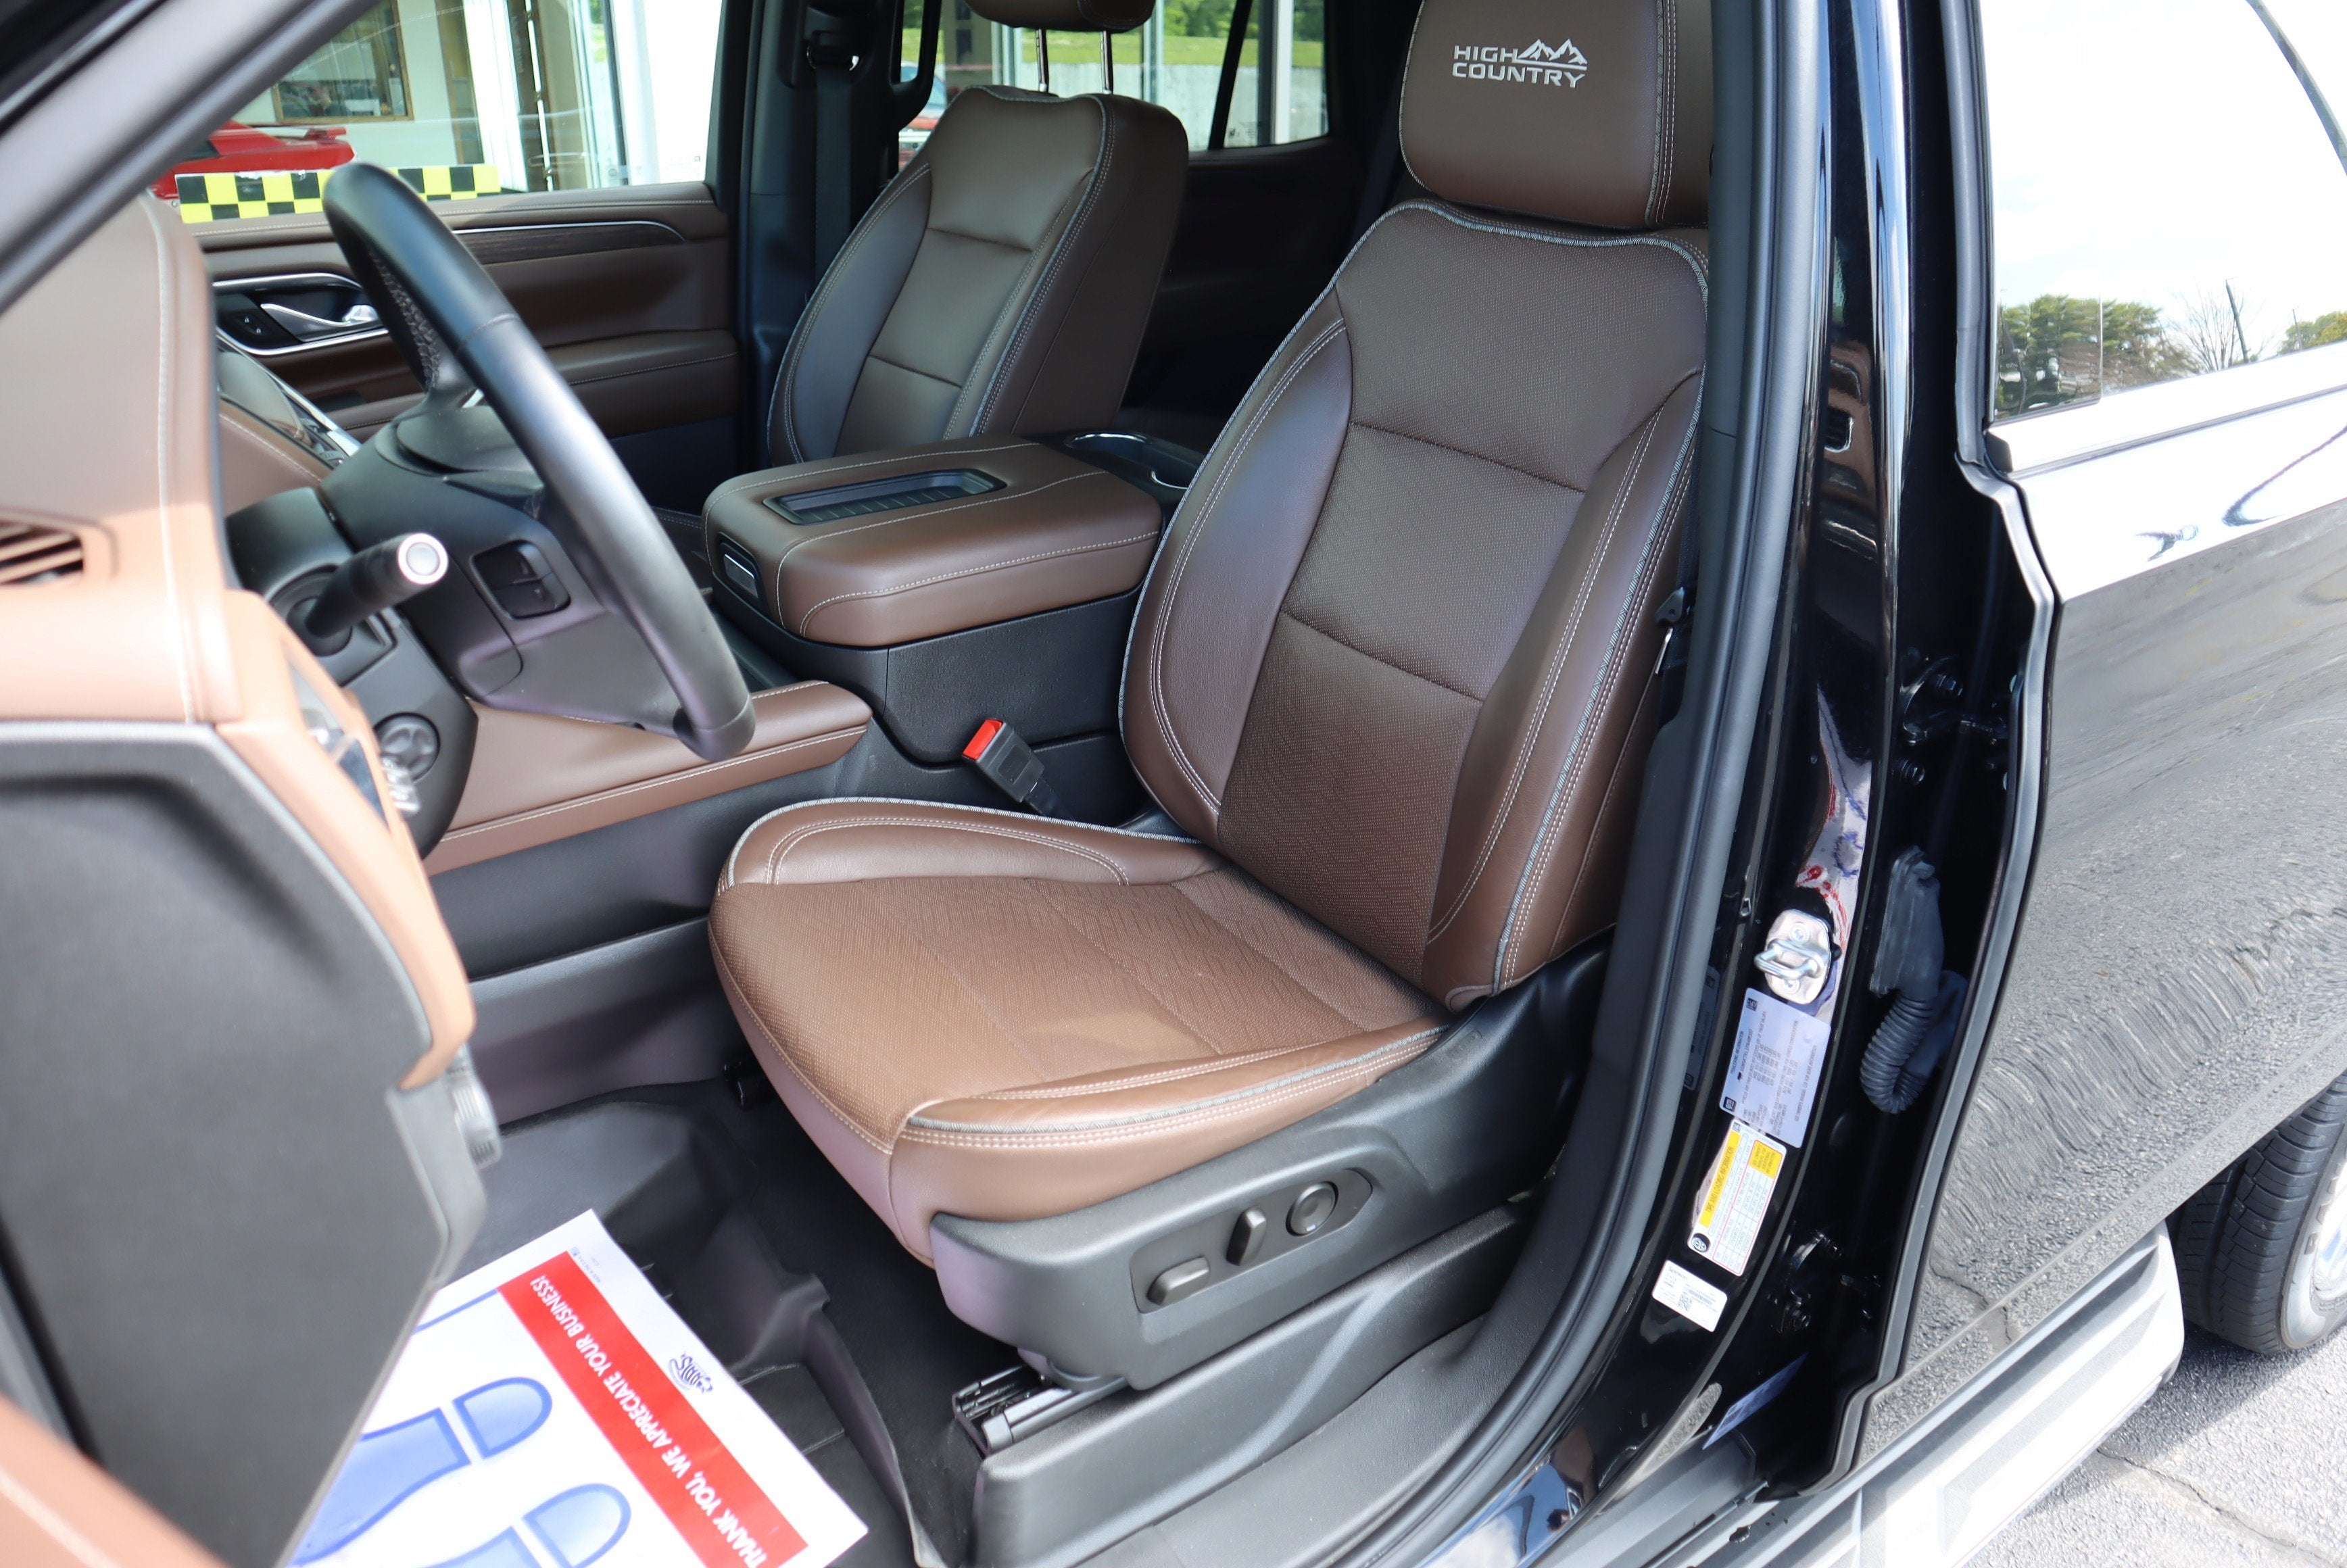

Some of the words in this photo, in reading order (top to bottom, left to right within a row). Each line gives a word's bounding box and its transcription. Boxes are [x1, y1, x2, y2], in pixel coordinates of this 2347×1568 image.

[1452, 62, 1586, 89] COUNTRY
[1453, 45, 1519, 64] HIGH
[531, 1276, 583, 1337] BUSINESS!
[576, 1335, 610, 1376] YOUR
[604, 1373, 671, 1448] APPRECIATE
[662, 1446, 690, 1478] WE
[686, 1472, 721, 1516] YOU,
[712, 1508, 768, 1568] THANK
